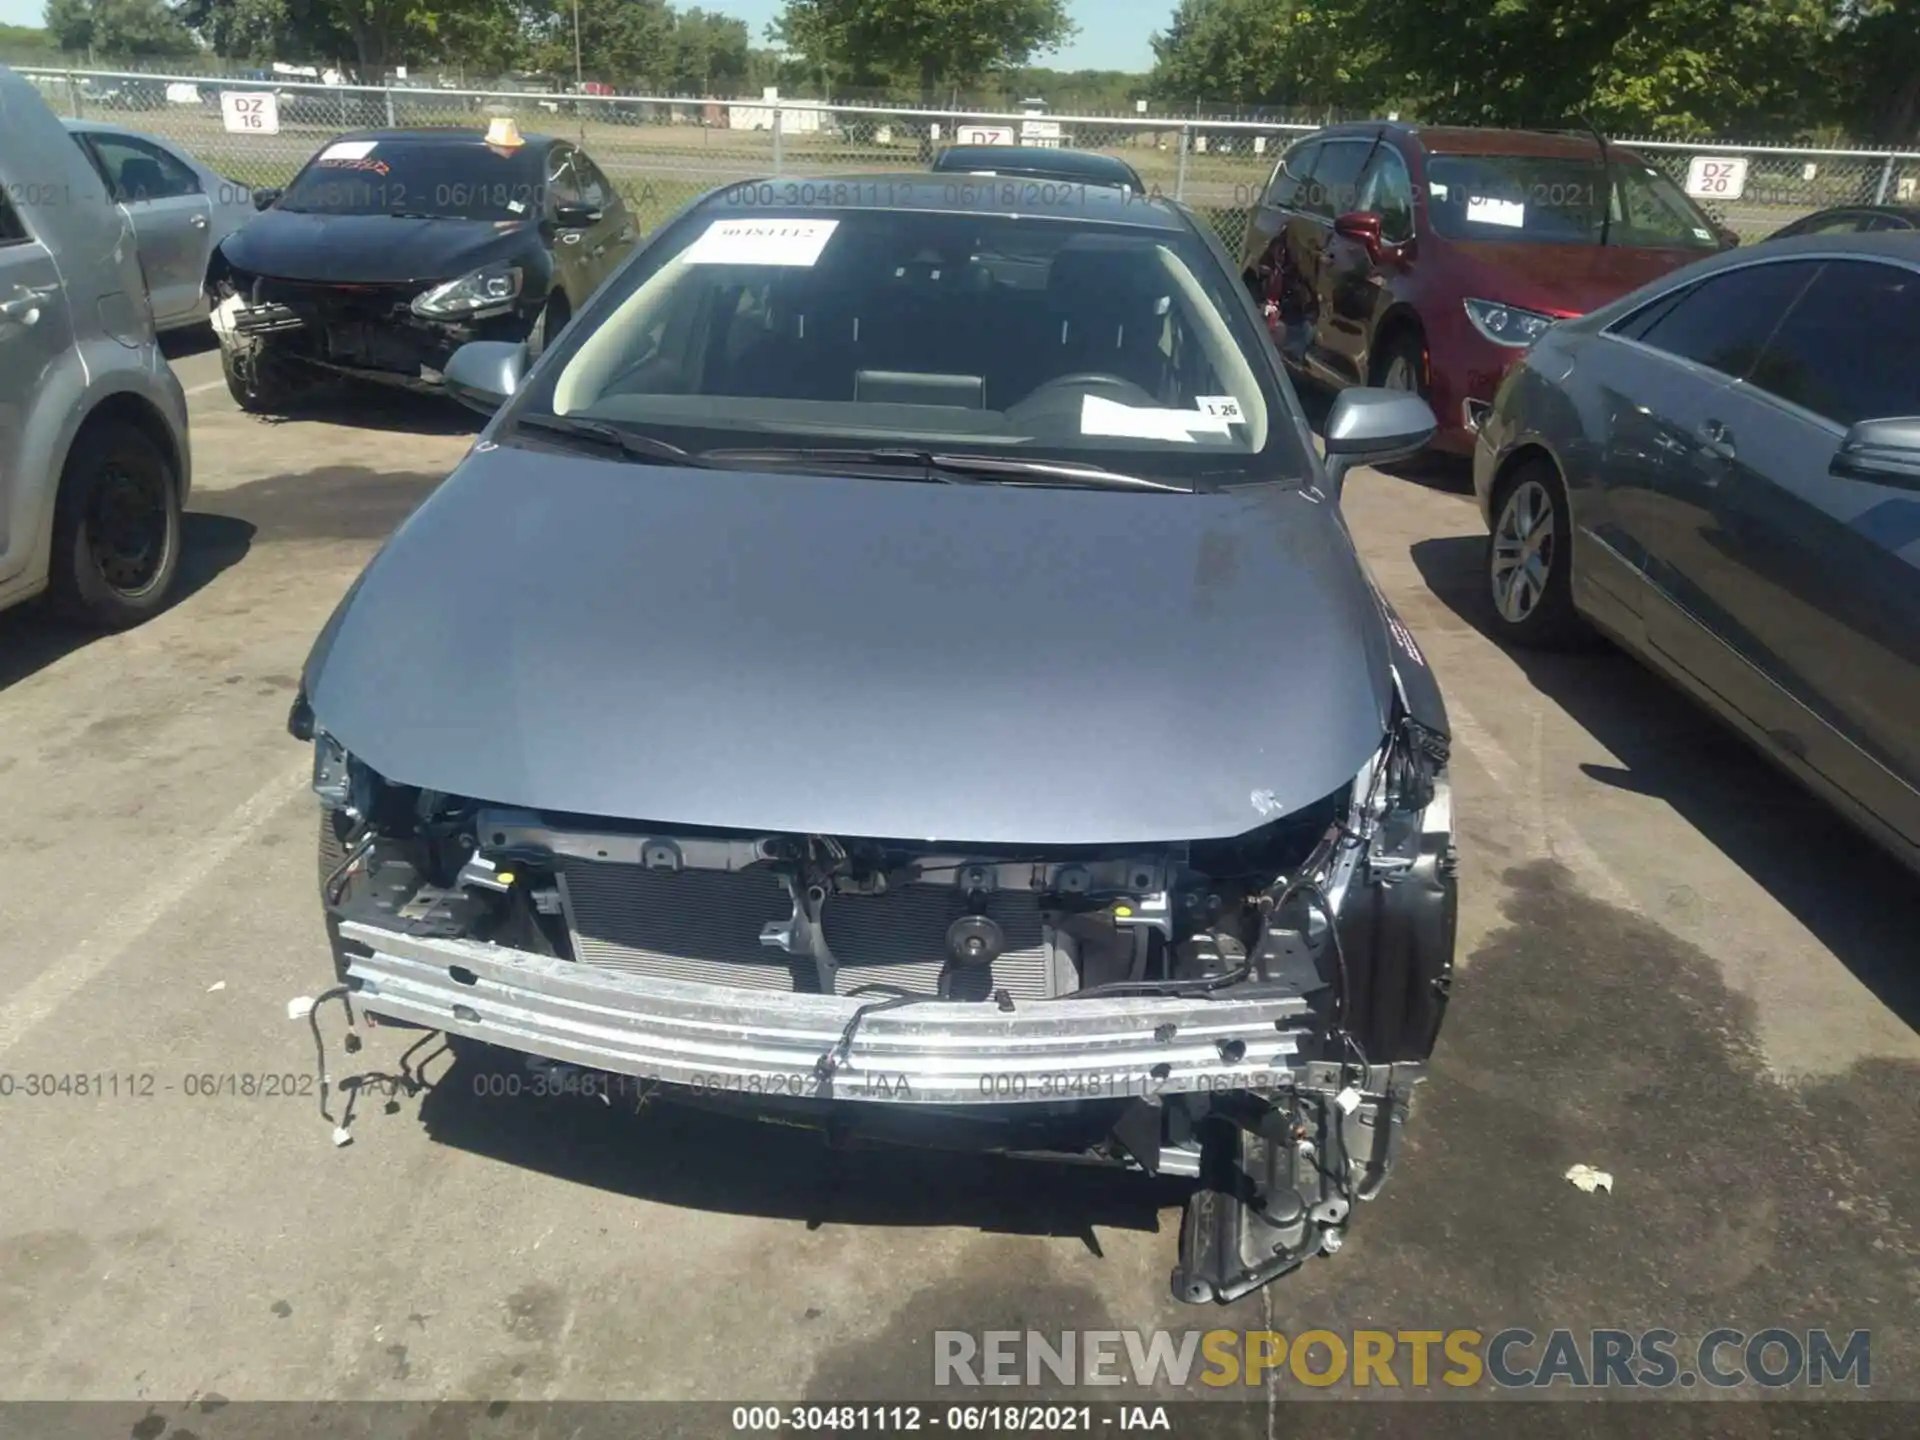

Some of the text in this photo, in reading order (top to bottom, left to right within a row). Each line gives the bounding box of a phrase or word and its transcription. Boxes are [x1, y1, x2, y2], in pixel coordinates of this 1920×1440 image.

[234, 98, 264, 113] DZ
[240, 115, 262, 128] 16
[972, 132, 1001, 144] DZ
[1703, 163, 1735, 178] DZ
[1701, 178, 1727, 192] 20
[1220, 404, 1238, 416] 26
